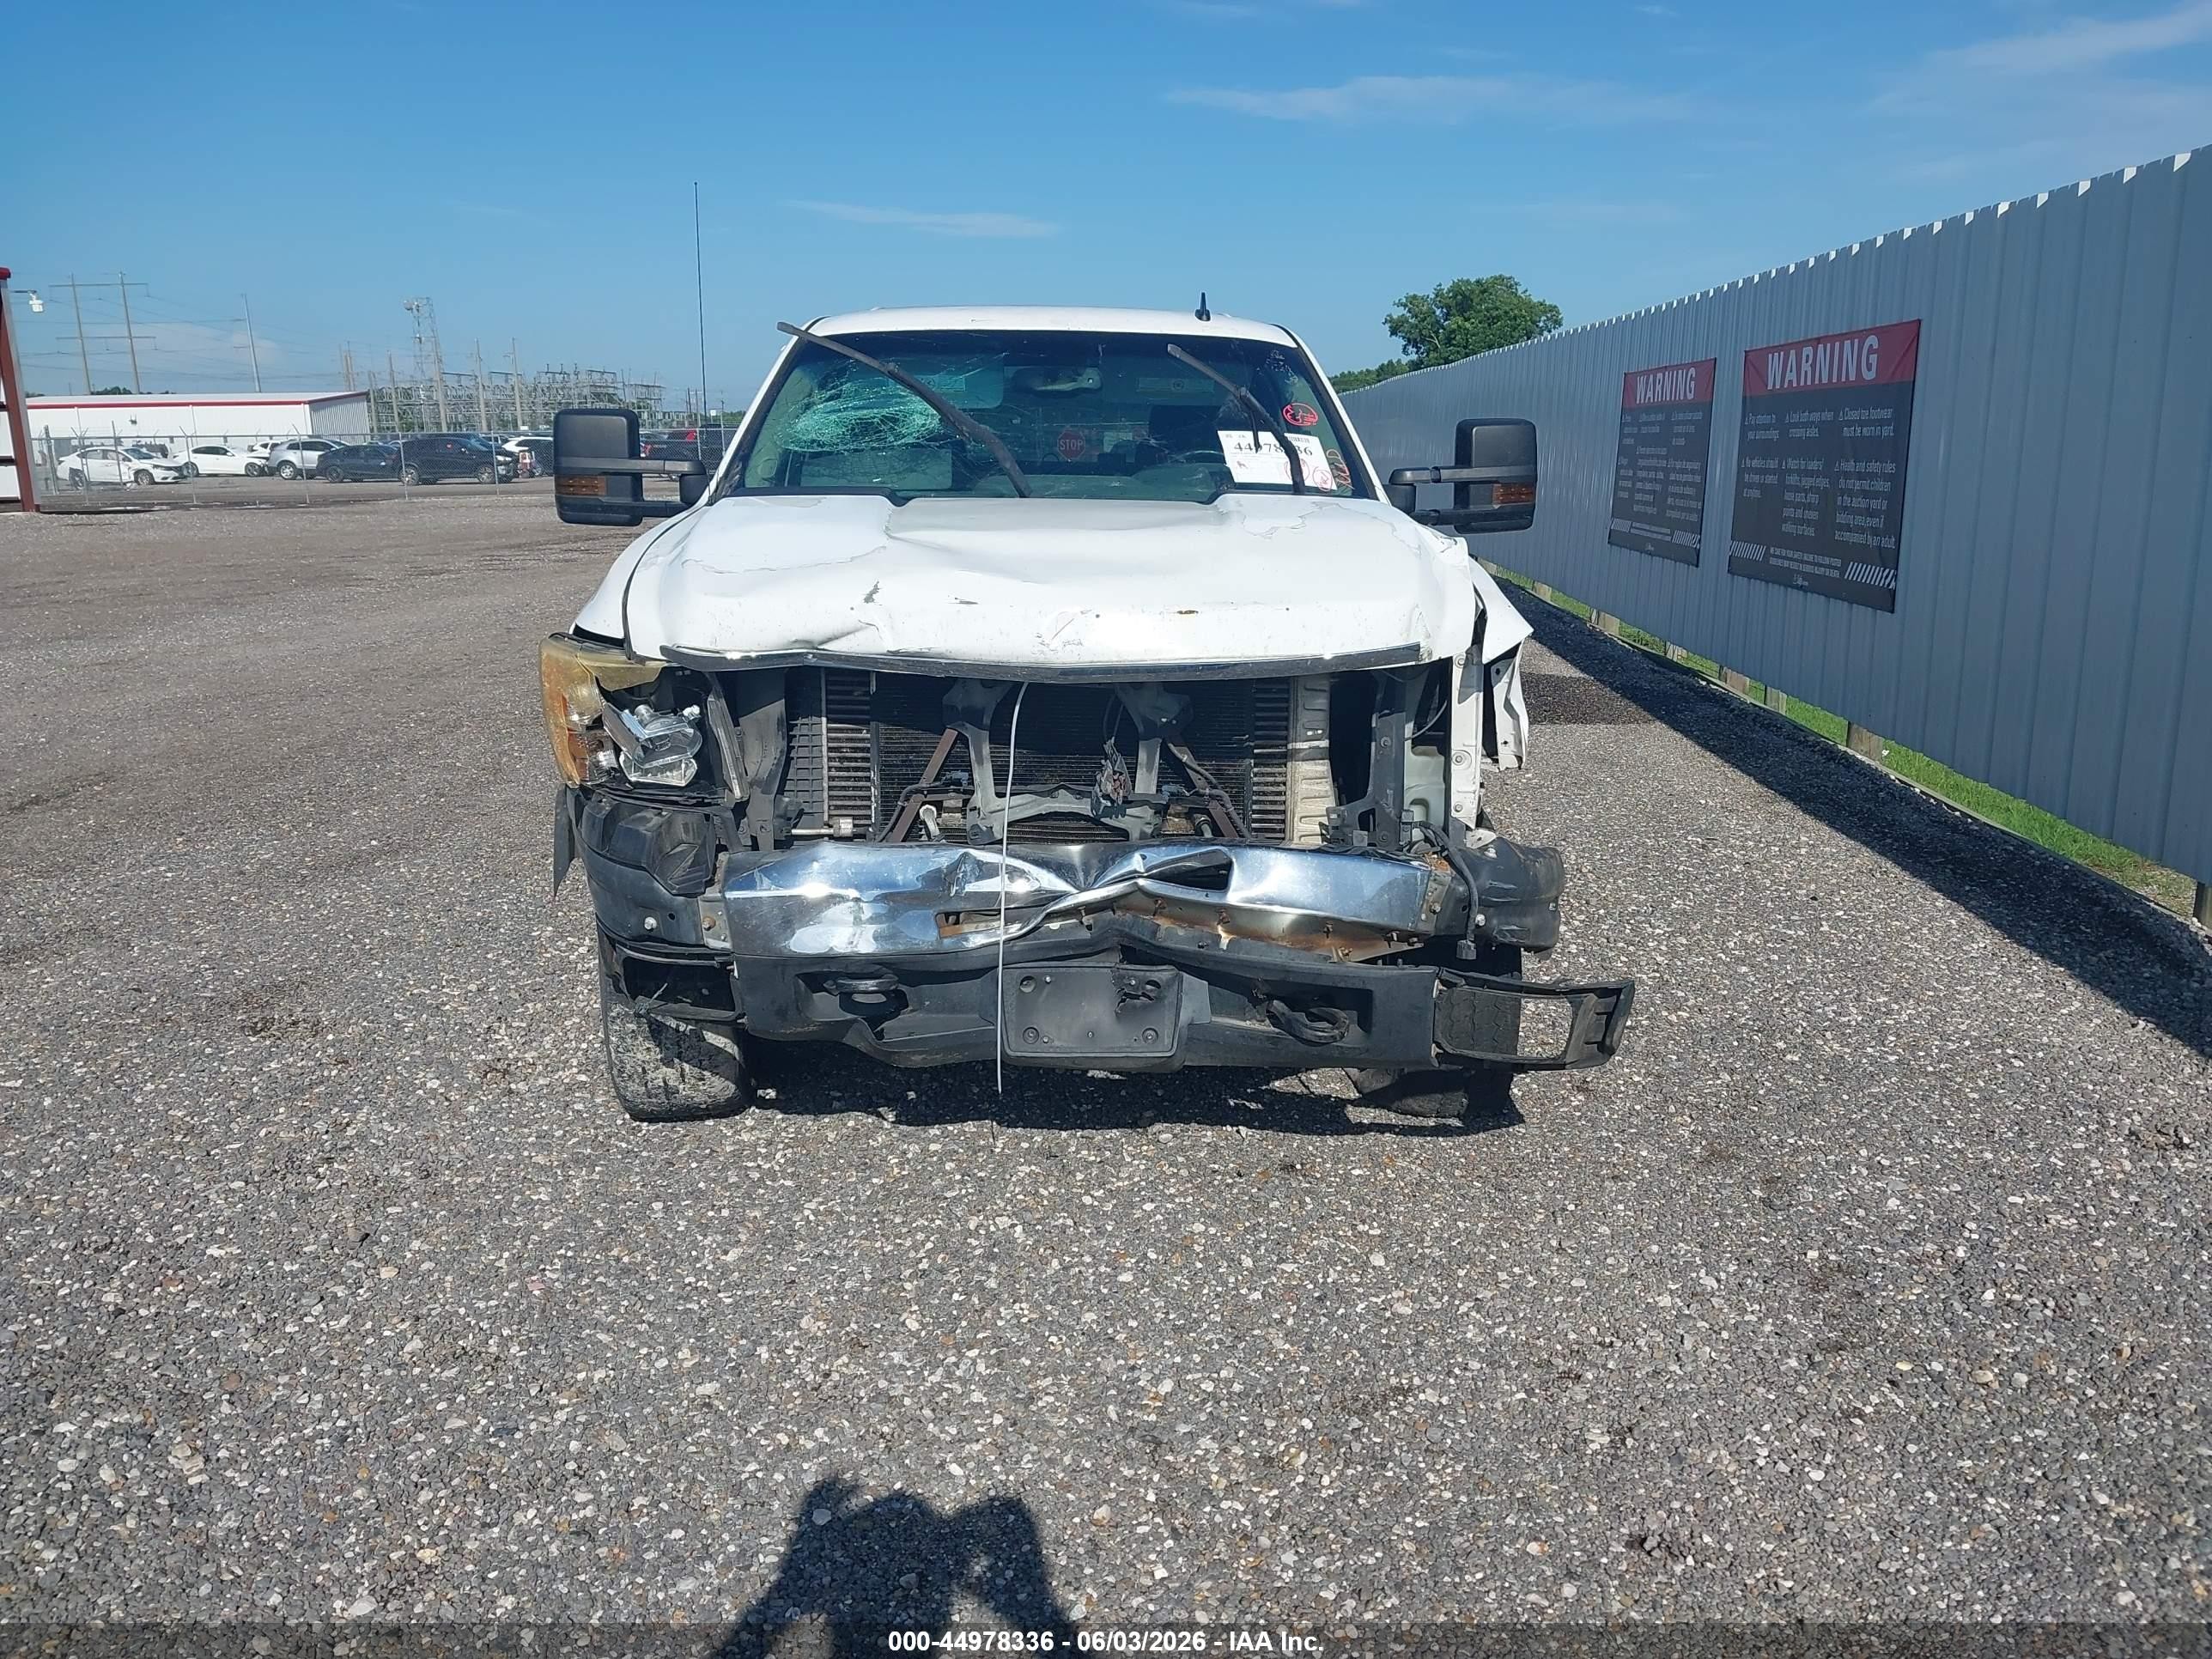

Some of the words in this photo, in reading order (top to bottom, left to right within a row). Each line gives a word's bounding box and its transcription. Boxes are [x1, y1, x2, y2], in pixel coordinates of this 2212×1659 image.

[1766, 335, 1879, 391] WARNING
[1636, 367, 1696, 404] WARNING
[1869, 407, 1893, 419] footwear
[1060, 439, 1084, 451] STOP
[1234, 441, 1313, 456] 447836
[1866, 459, 1881, 475] safety
[1882, 460, 1896, 473] rules
